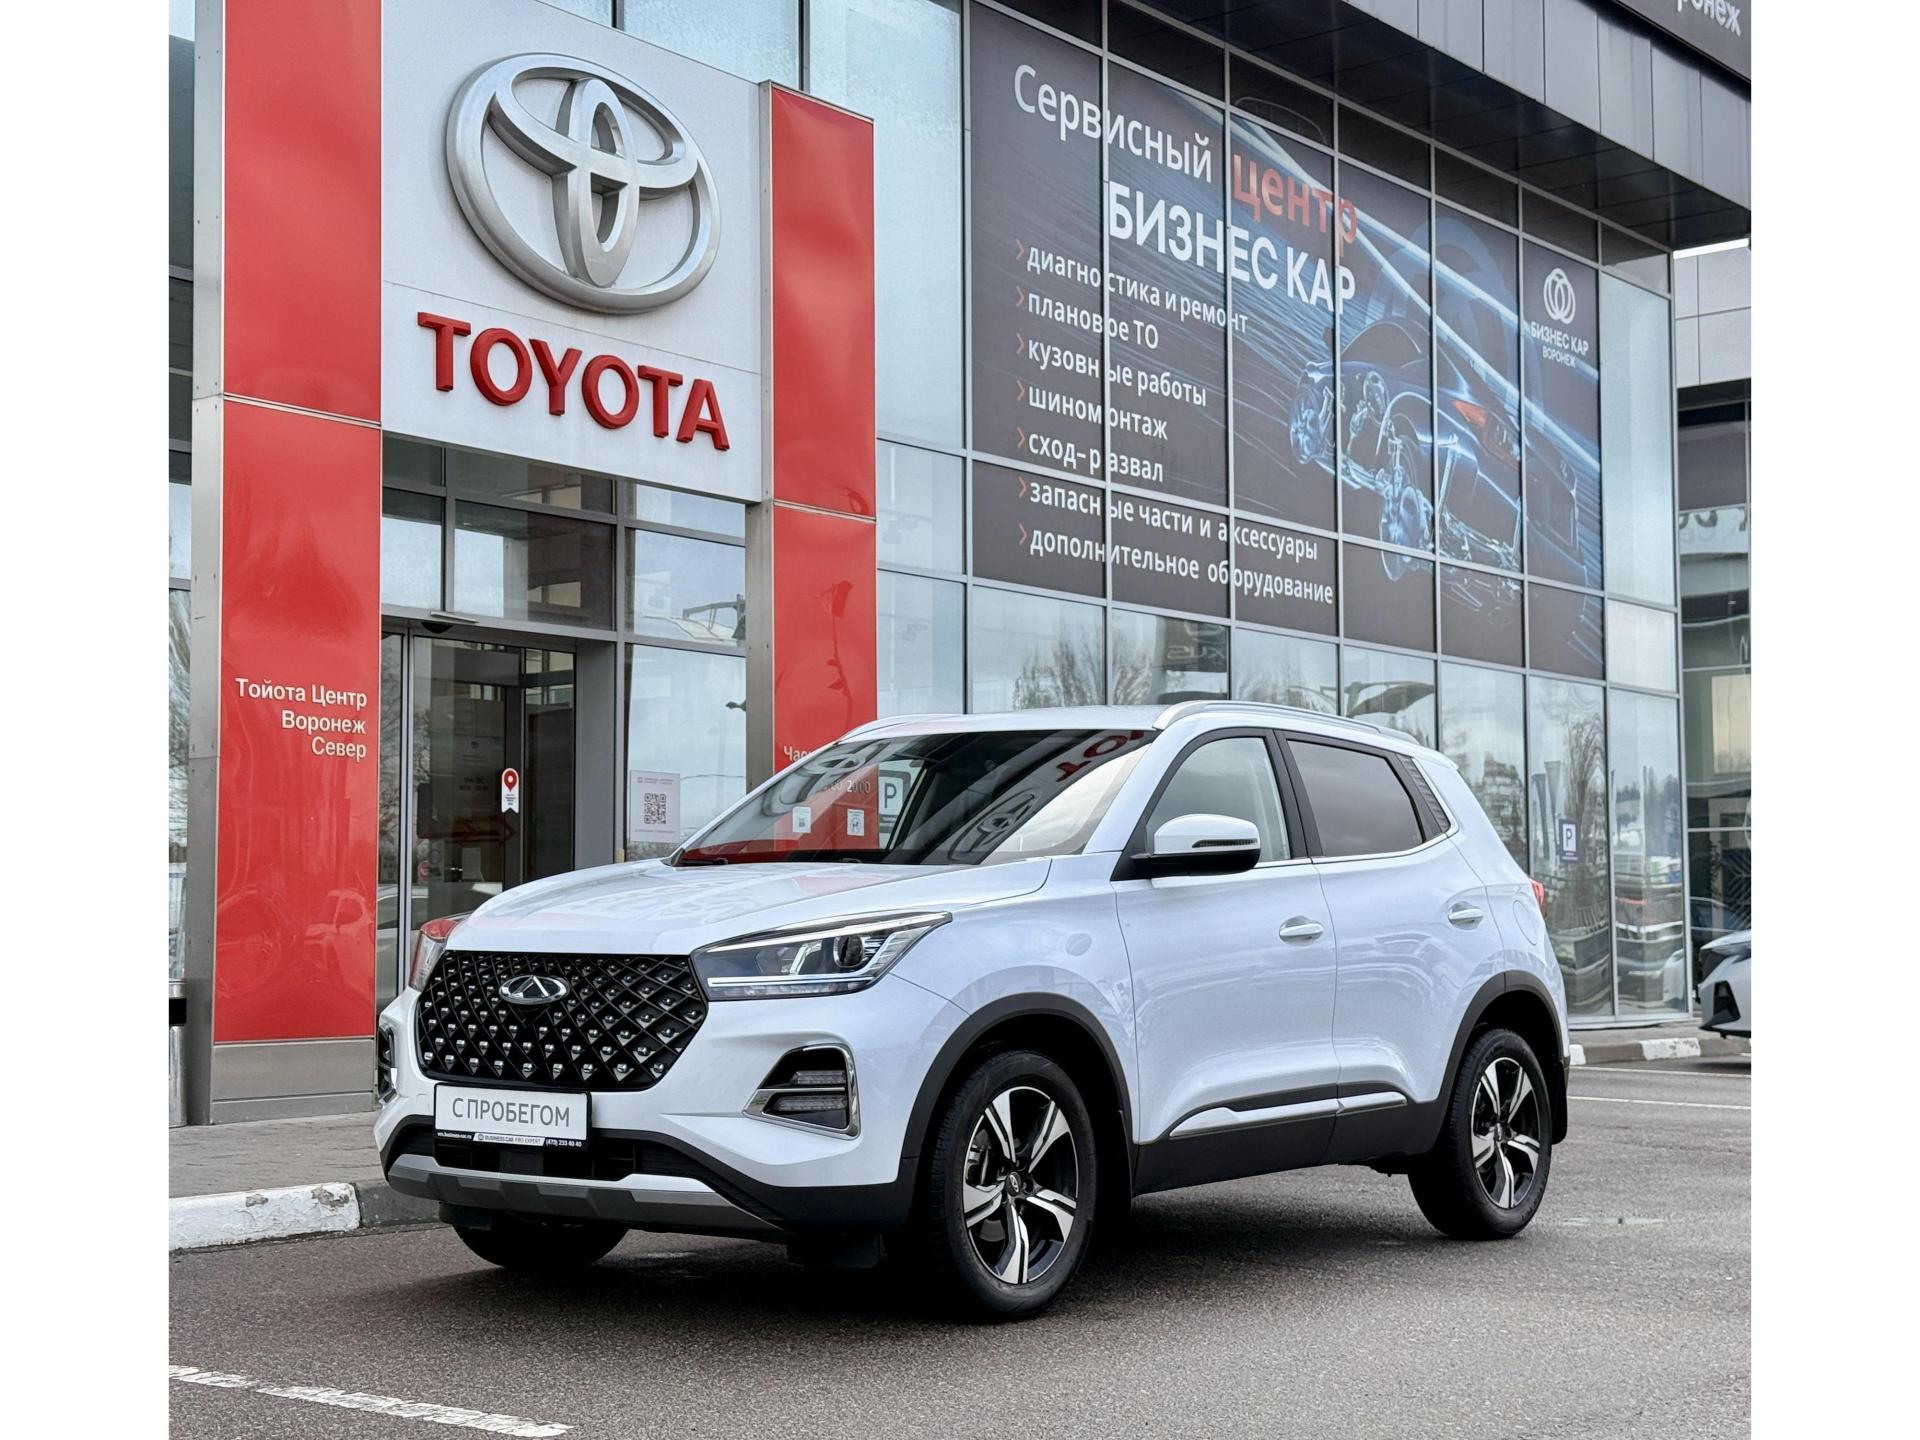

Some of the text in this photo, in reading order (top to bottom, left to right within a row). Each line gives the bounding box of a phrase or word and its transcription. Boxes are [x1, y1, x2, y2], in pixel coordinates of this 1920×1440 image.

[1014, 64, 1358, 258] Сервисный центр
[1109, 181, 1356, 316] БИЗНЕС КАР
[1026, 246, 1248, 333] диагностика и ремонт
[1028, 294, 1160, 350] плановое ТО
[1531, 321, 1589, 356] БИЗНЕС КАР
[417, 311, 731, 452] TOYOTA
[1028, 338, 1207, 407] кузовные работы
[1028, 385, 1168, 441] шиномонтаж
[1028, 432, 1163, 483] сход-развал
[1029, 482, 1318, 562] запасные части и аксессуары
[1030, 529, 1334, 605] дополнительное оборудование
[235, 678, 367, 710] Тойота Центр
[282, 709, 366, 735] Воронеж
[312, 736, 366, 763] Север
[452, 1098, 570, 1128] С ПРОБЕГОМ
